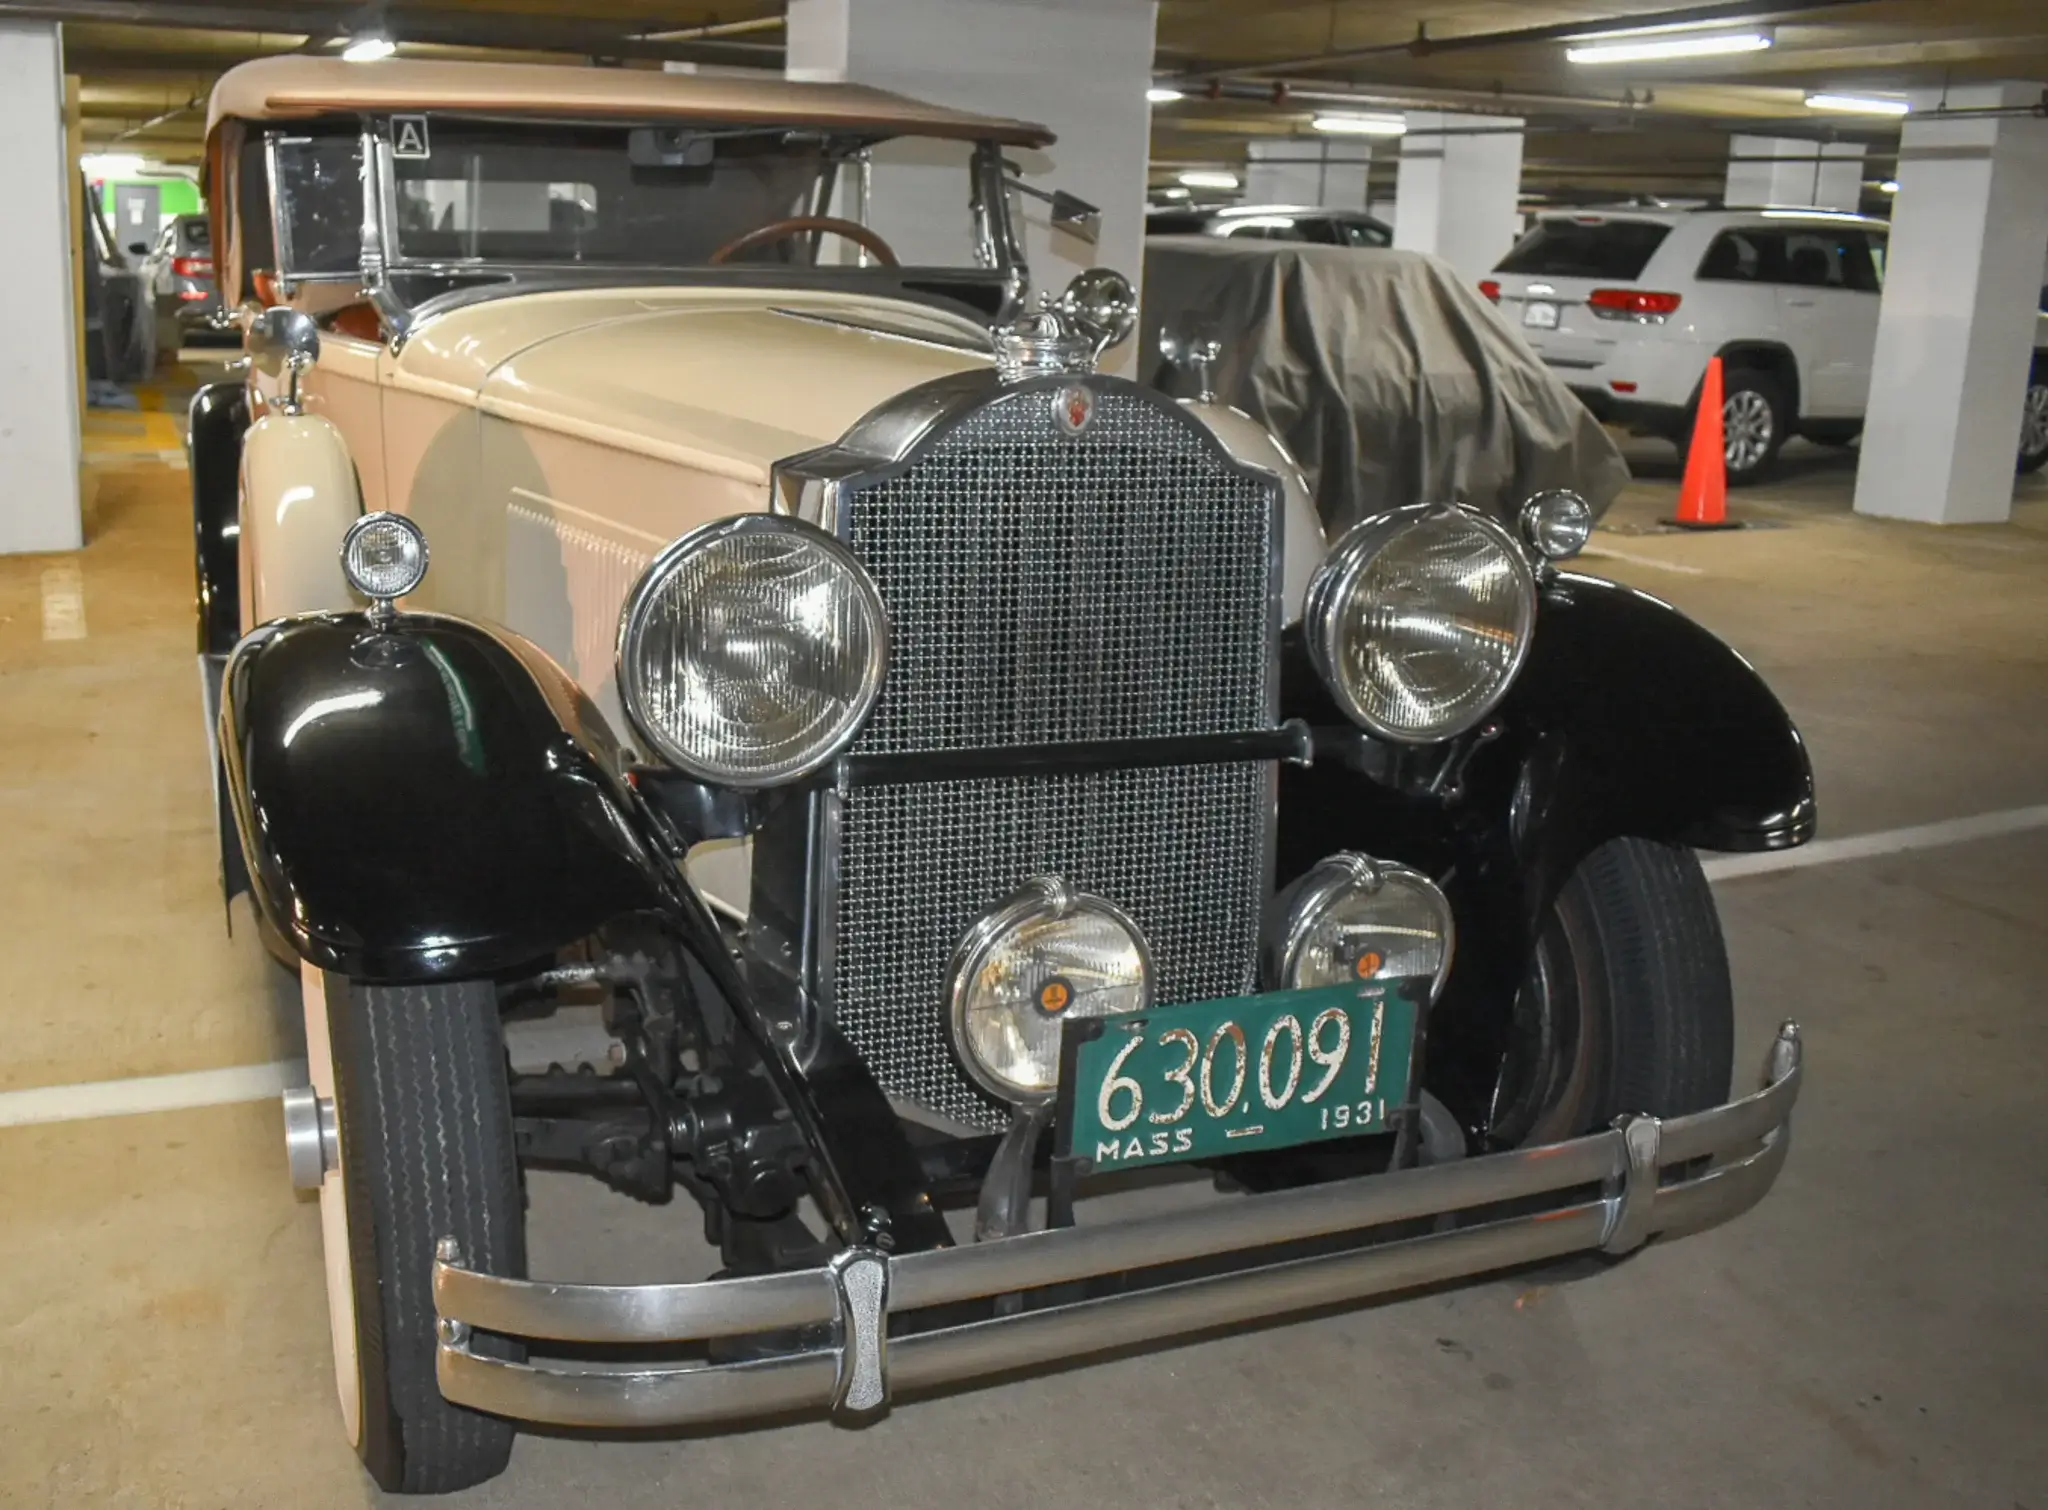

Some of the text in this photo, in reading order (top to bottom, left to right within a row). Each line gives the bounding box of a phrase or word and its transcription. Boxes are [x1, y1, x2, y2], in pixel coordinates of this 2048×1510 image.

[398, 122, 423, 150] A
[1320, 1098, 1385, 1130] 1931
[1096, 1128, 1193, 1163] MASS
